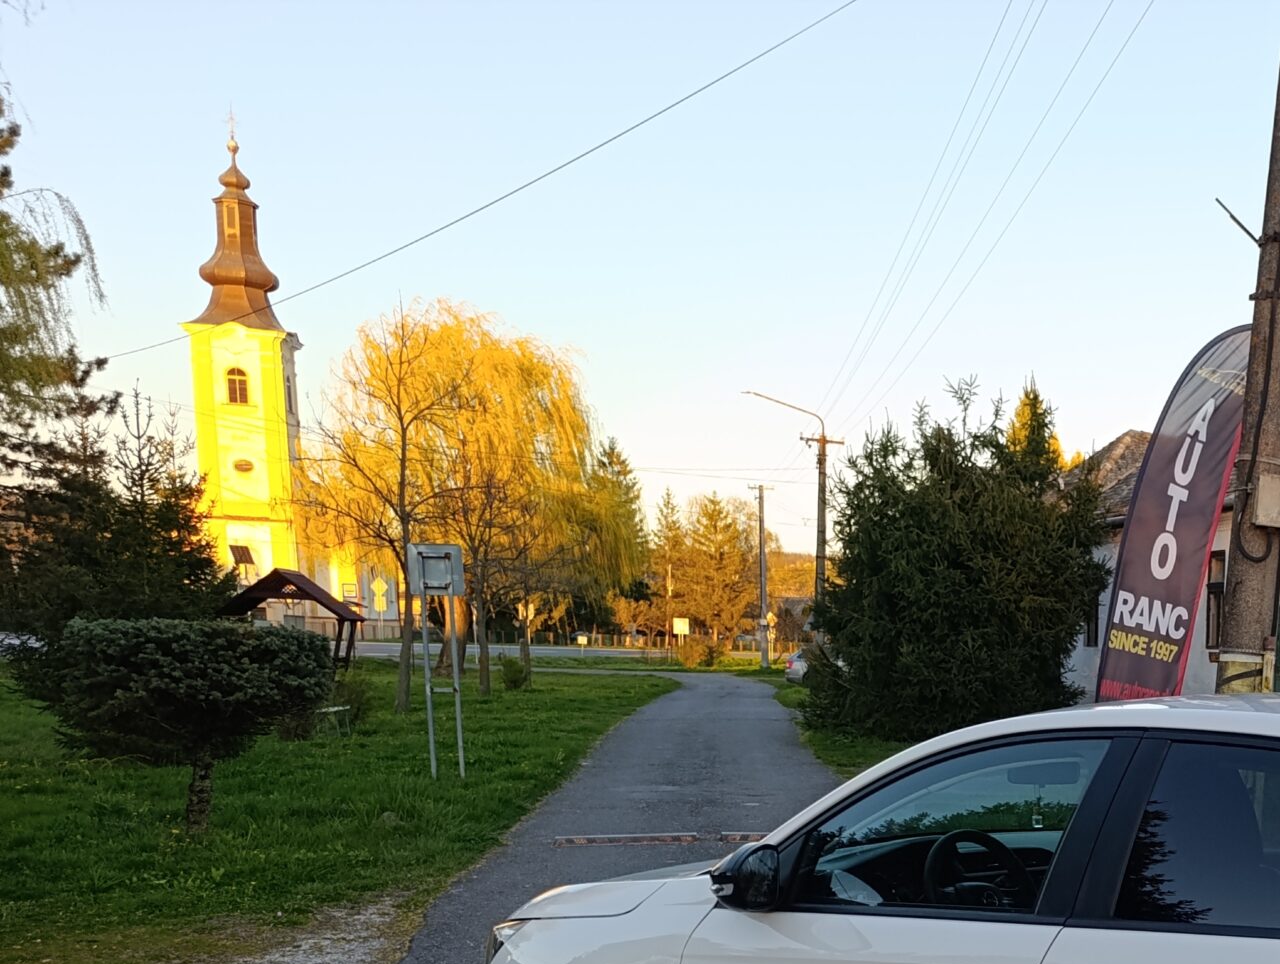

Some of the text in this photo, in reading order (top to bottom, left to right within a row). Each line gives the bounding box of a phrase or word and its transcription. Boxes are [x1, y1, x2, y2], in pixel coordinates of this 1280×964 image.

[1150, 398, 1216, 581] AUTO
[1113, 589, 1189, 640] RANC
[1108, 629, 1179, 663] SINCE 1997
